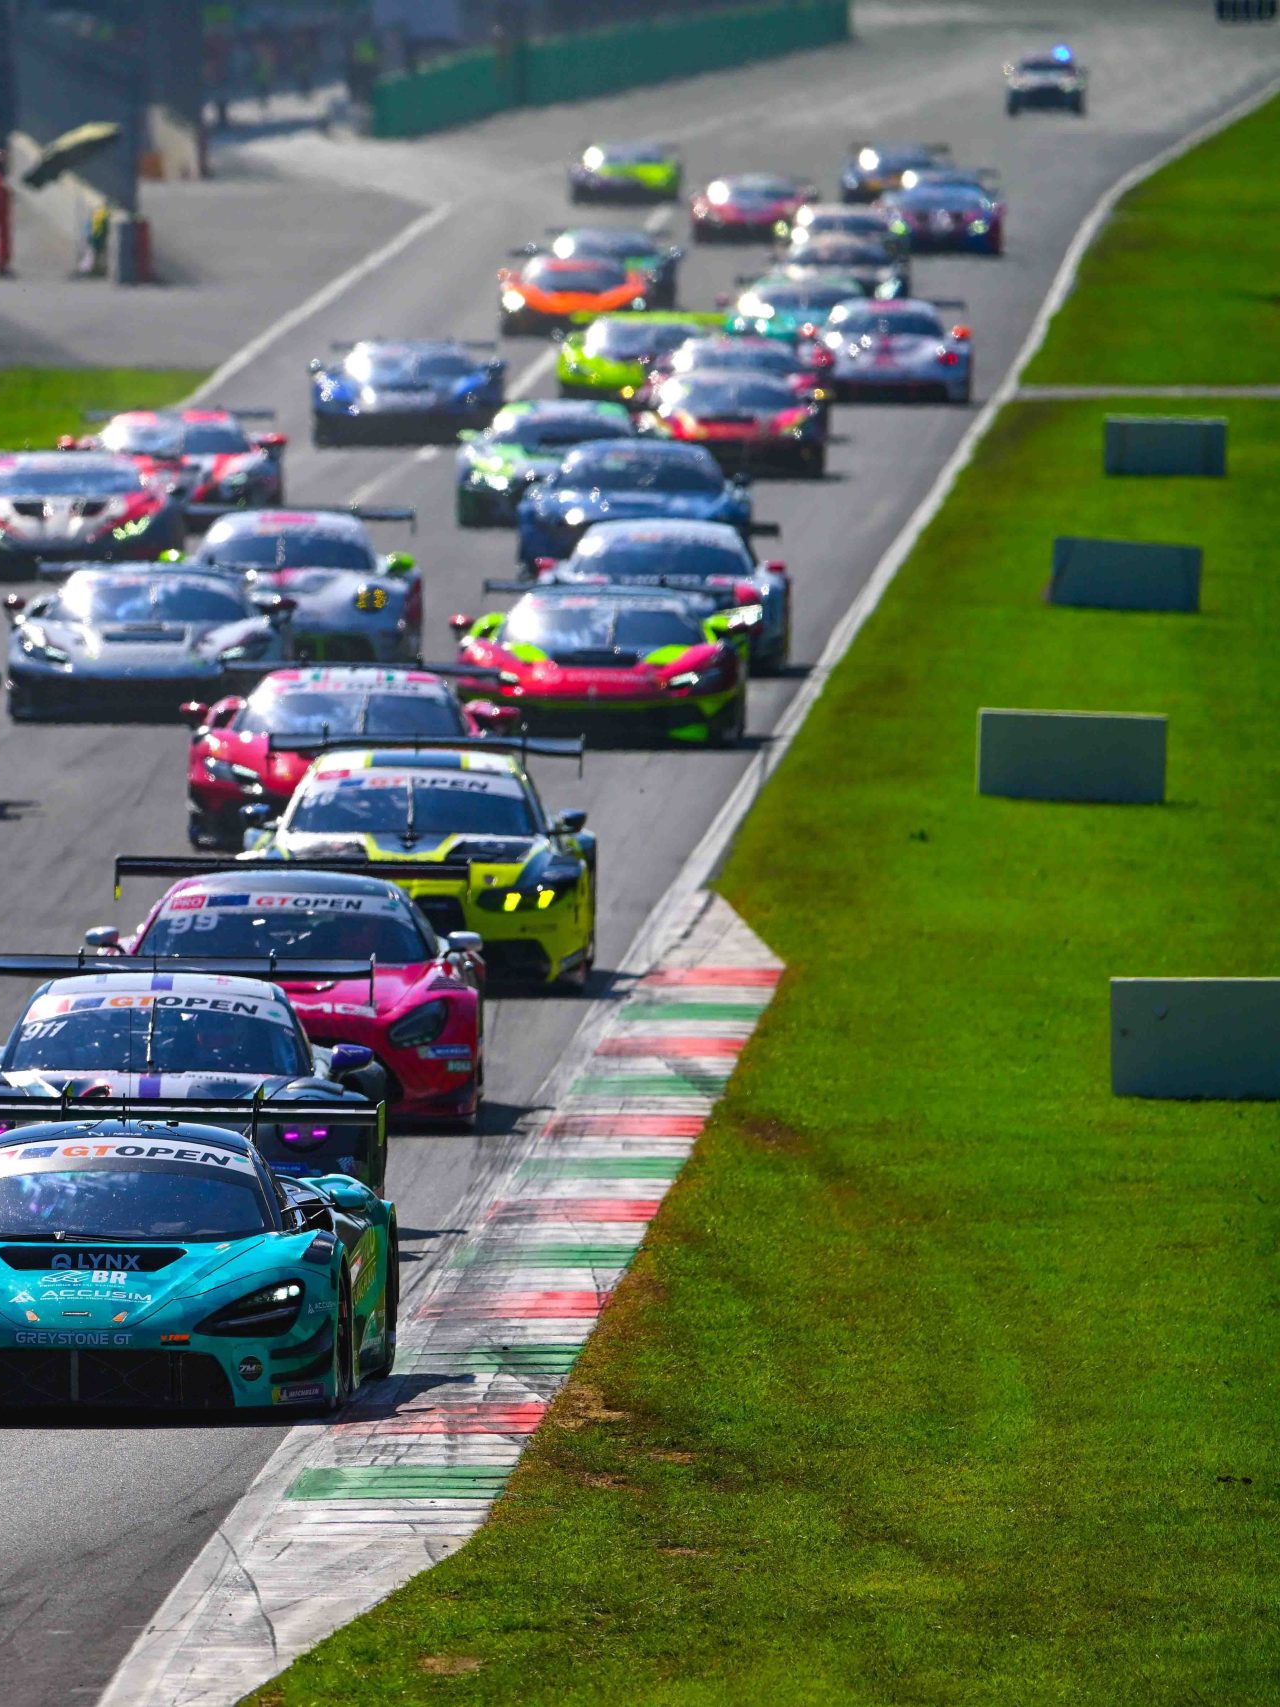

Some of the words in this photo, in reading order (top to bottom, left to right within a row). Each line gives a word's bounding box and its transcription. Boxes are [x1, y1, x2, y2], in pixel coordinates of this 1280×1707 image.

[255, 896, 363, 910] GTOPEN
[167, 912, 219, 934] 99
[109, 996, 259, 1015] GTOPEN
[20, 1020, 68, 1042] 911
[61, 1145, 232, 1166] GTOPEN
[77, 1253, 141, 1271] LYNX
[91, 1270, 128, 1285] BR
[41, 1289, 152, 1302] ACCUSIM
[15, 1331, 109, 1346] GREYSTONE
[113, 1333, 133, 1346] GT
[288, 1387, 320, 1398] MICHELIN
